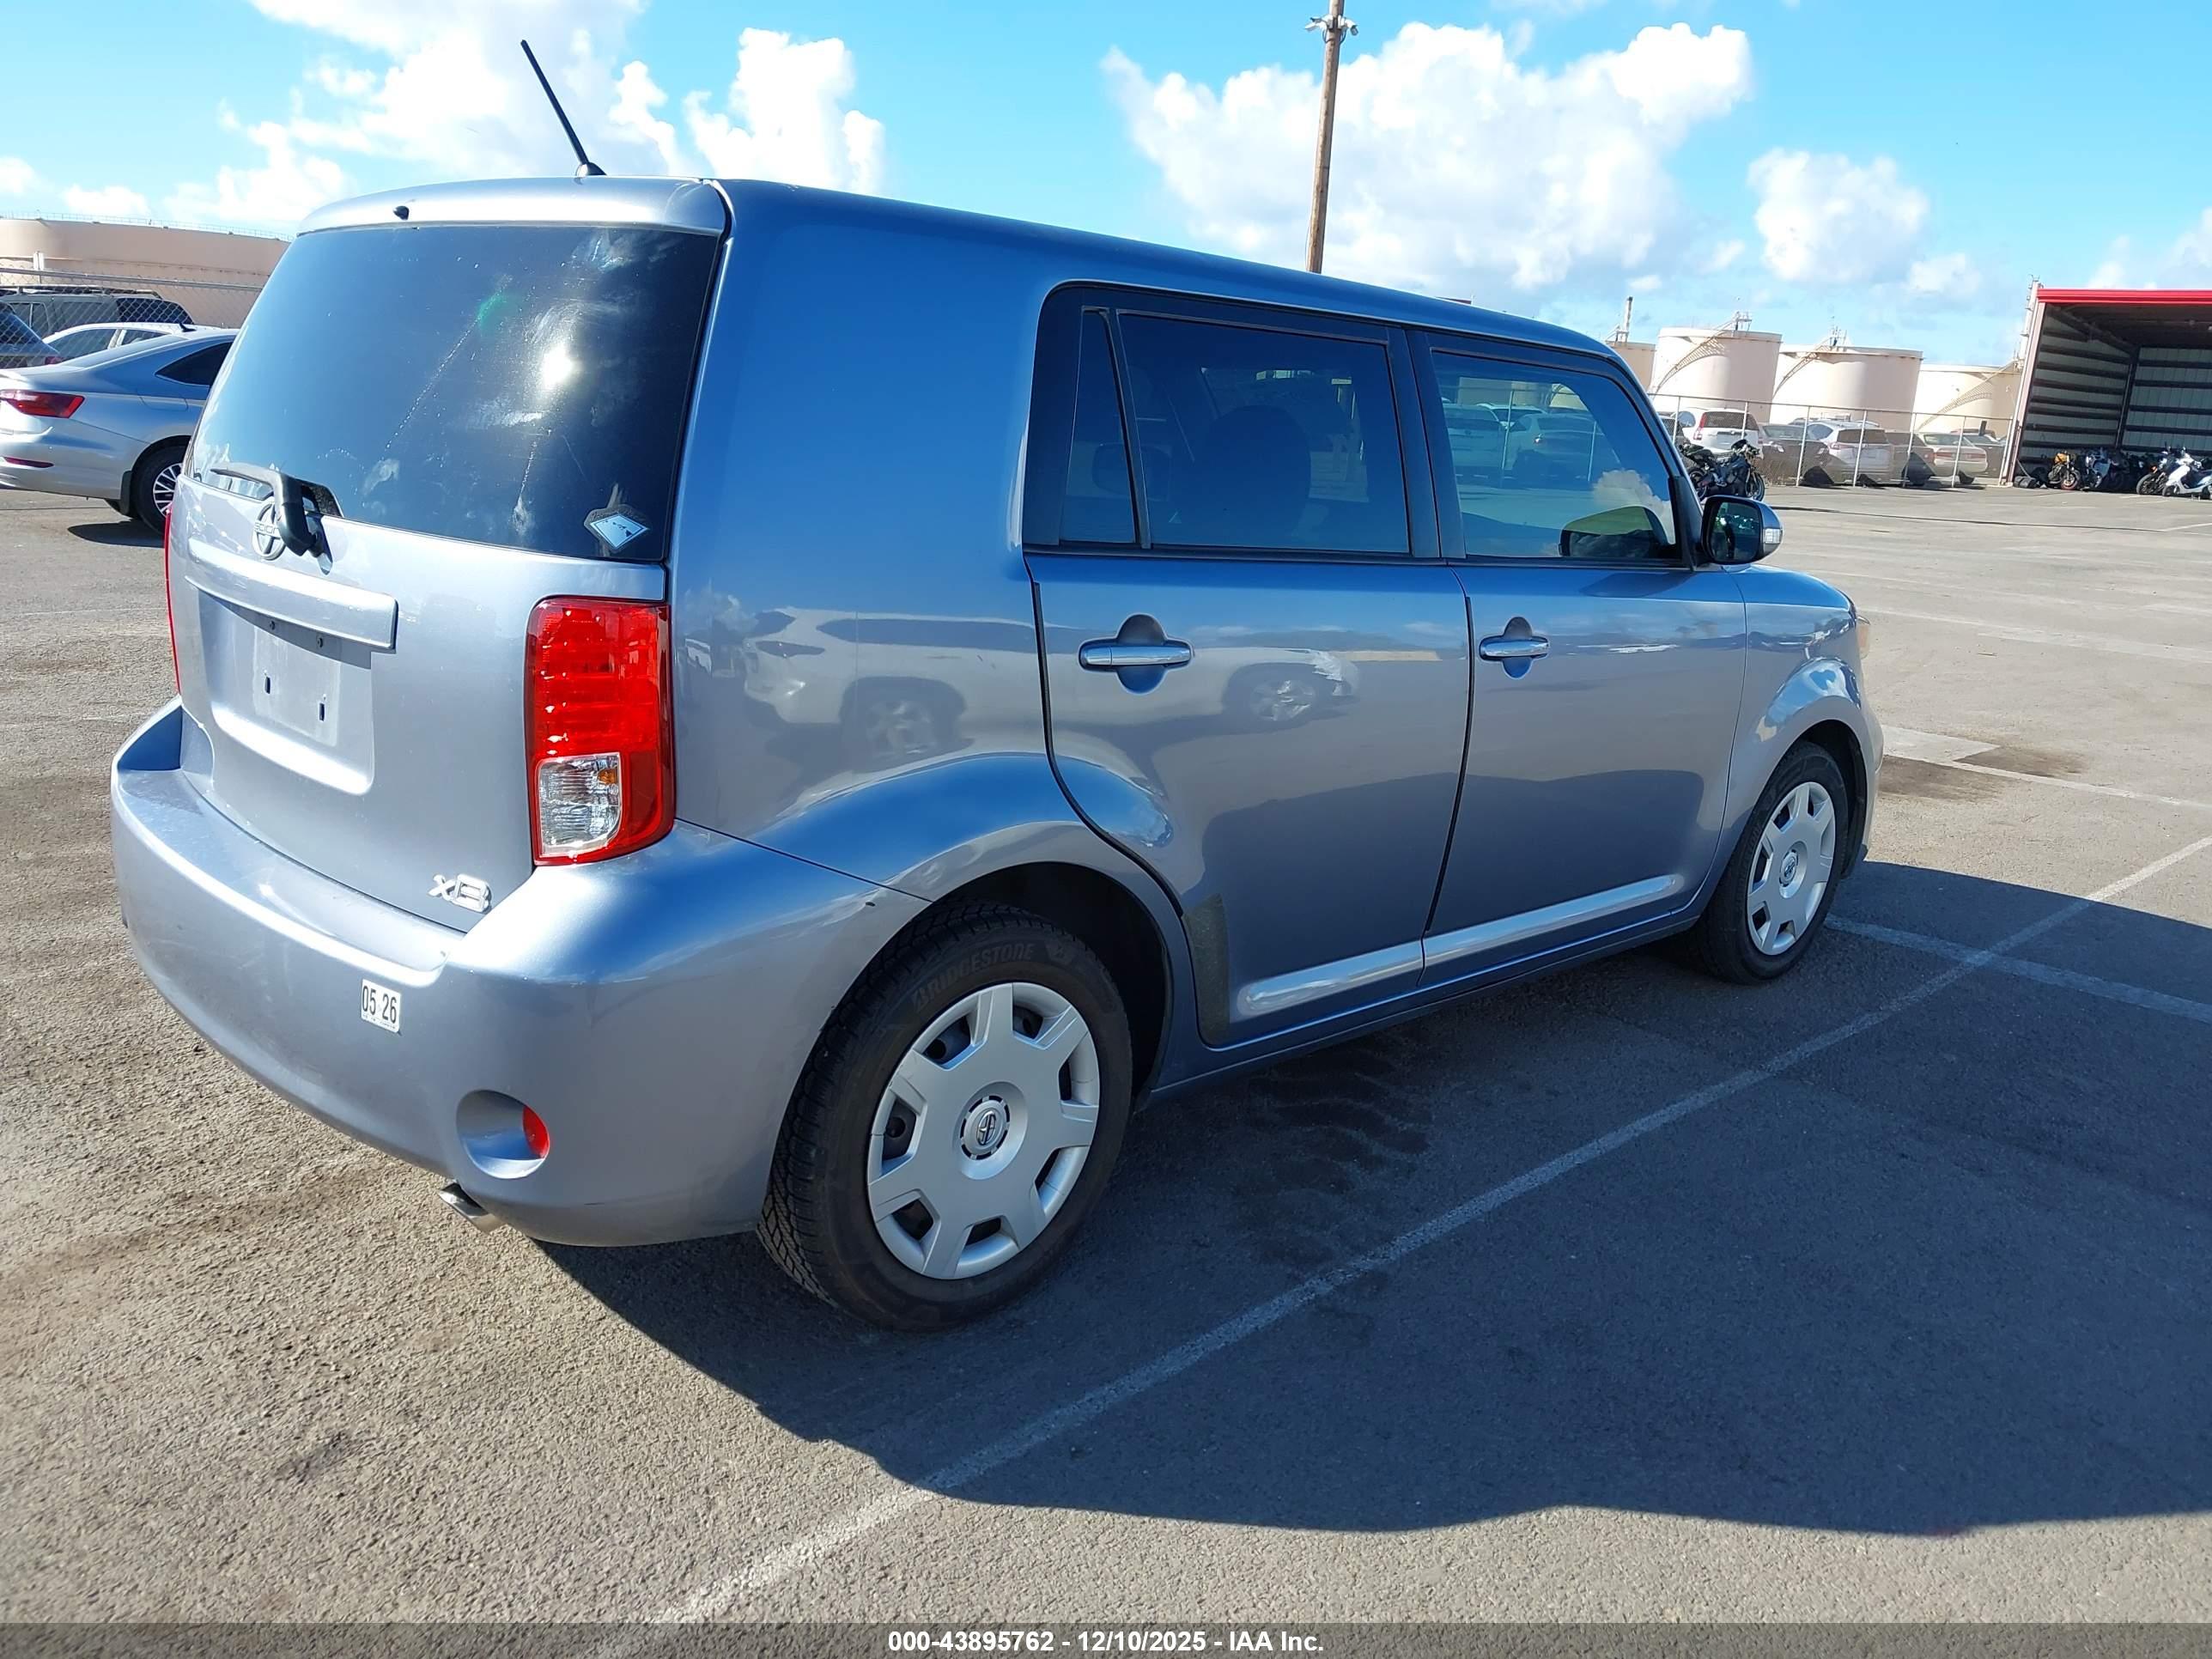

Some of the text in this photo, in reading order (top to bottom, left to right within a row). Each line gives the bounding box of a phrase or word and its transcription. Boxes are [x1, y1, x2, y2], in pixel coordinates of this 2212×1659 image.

[362, 985, 376, 1015] 05
[382, 993, 397, 1024] 26
[911, 943, 1036, 1013] BRIDGESTONE
